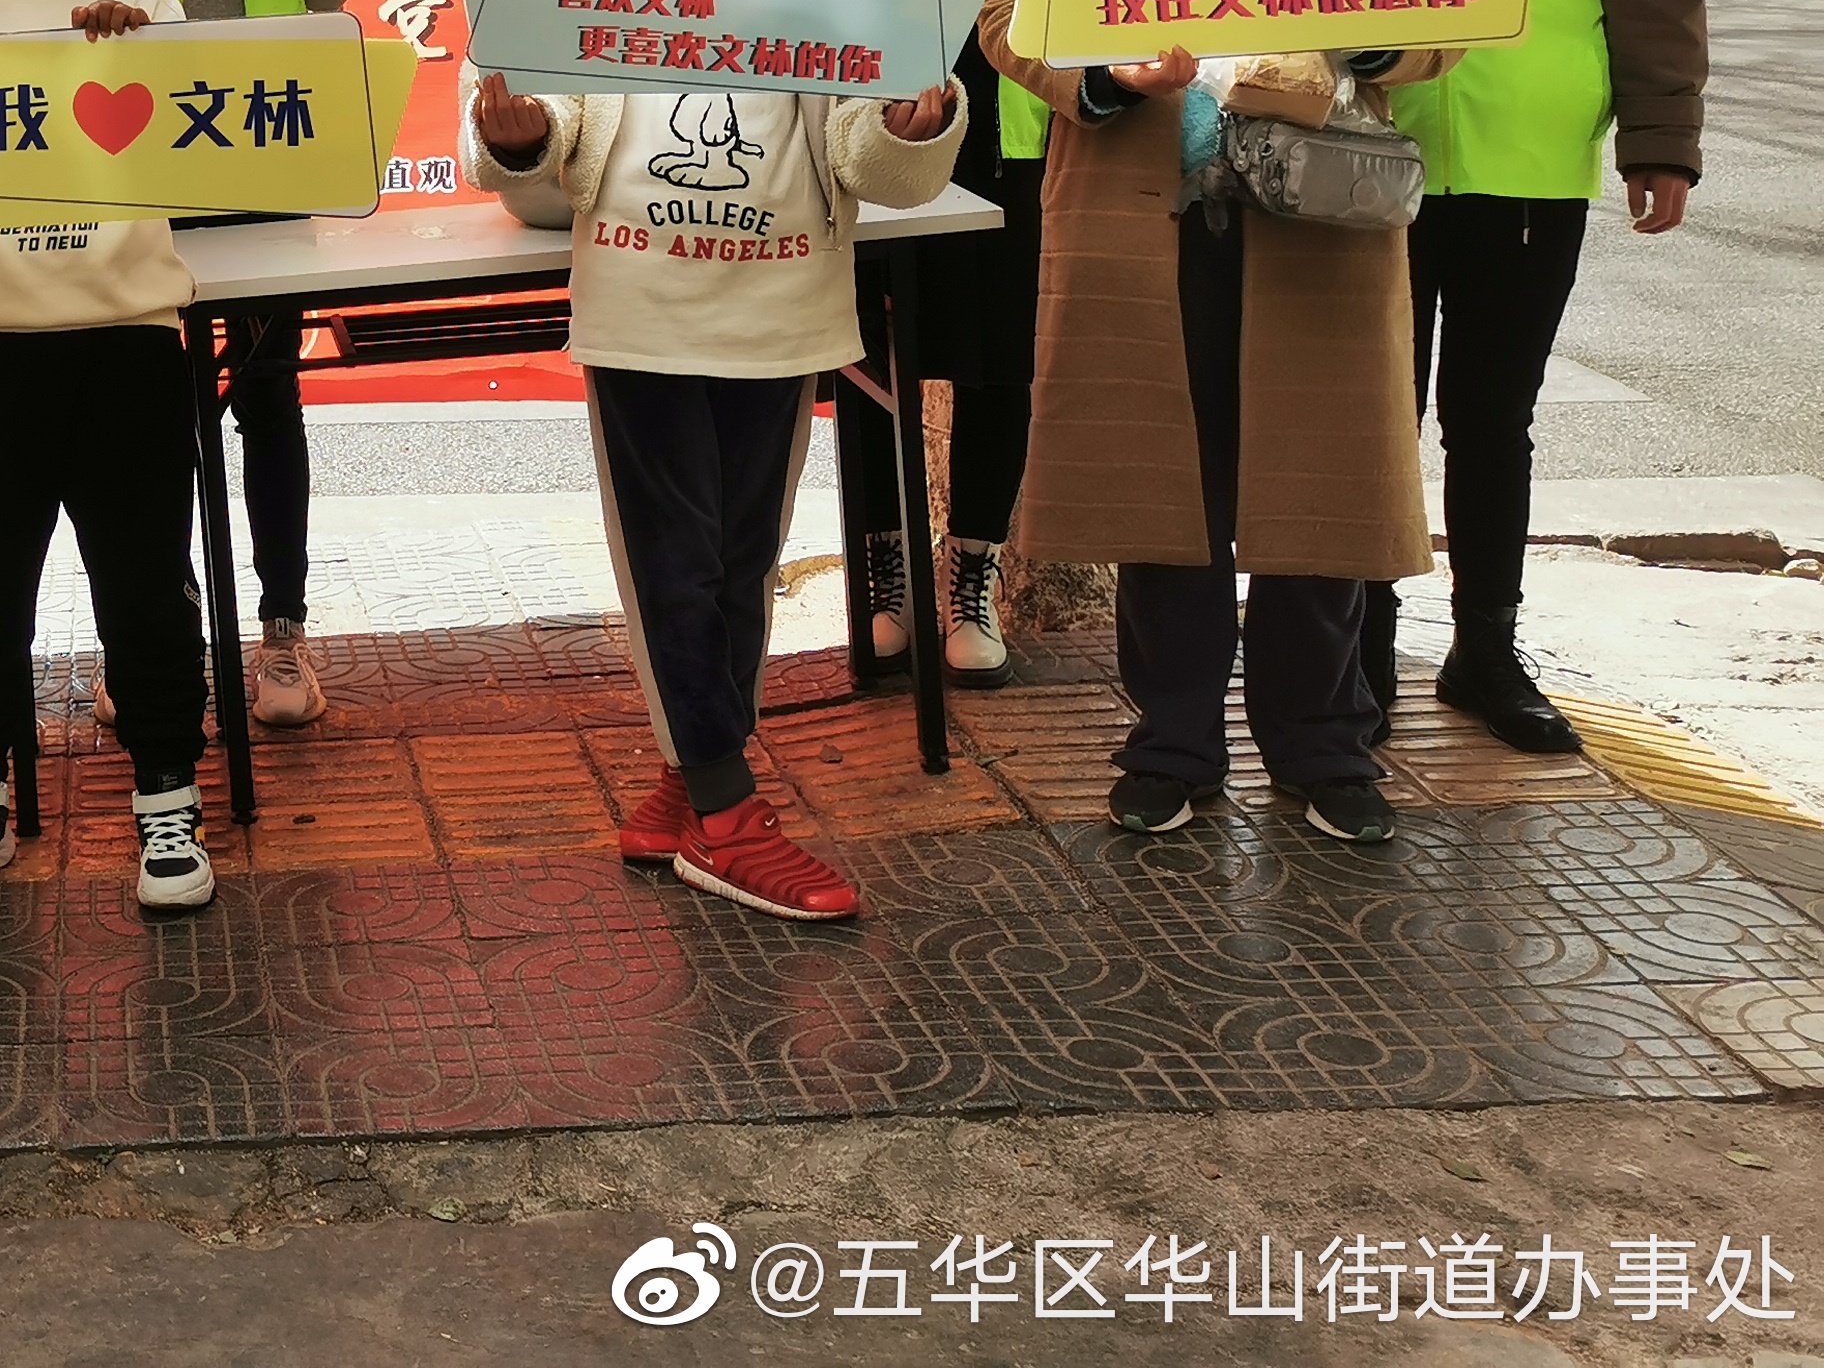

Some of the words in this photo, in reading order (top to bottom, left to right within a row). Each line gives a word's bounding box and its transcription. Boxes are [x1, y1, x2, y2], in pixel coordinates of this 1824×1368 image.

[575, 25, 884, 85] 更喜欢文林的你
[168, 78, 315, 150] 文林
[646, 199, 775, 237] COLLEGE
[17, 236, 40, 252] TO
[594, 221, 650, 252] LOS
[667, 233, 811, 262] ANGELES
